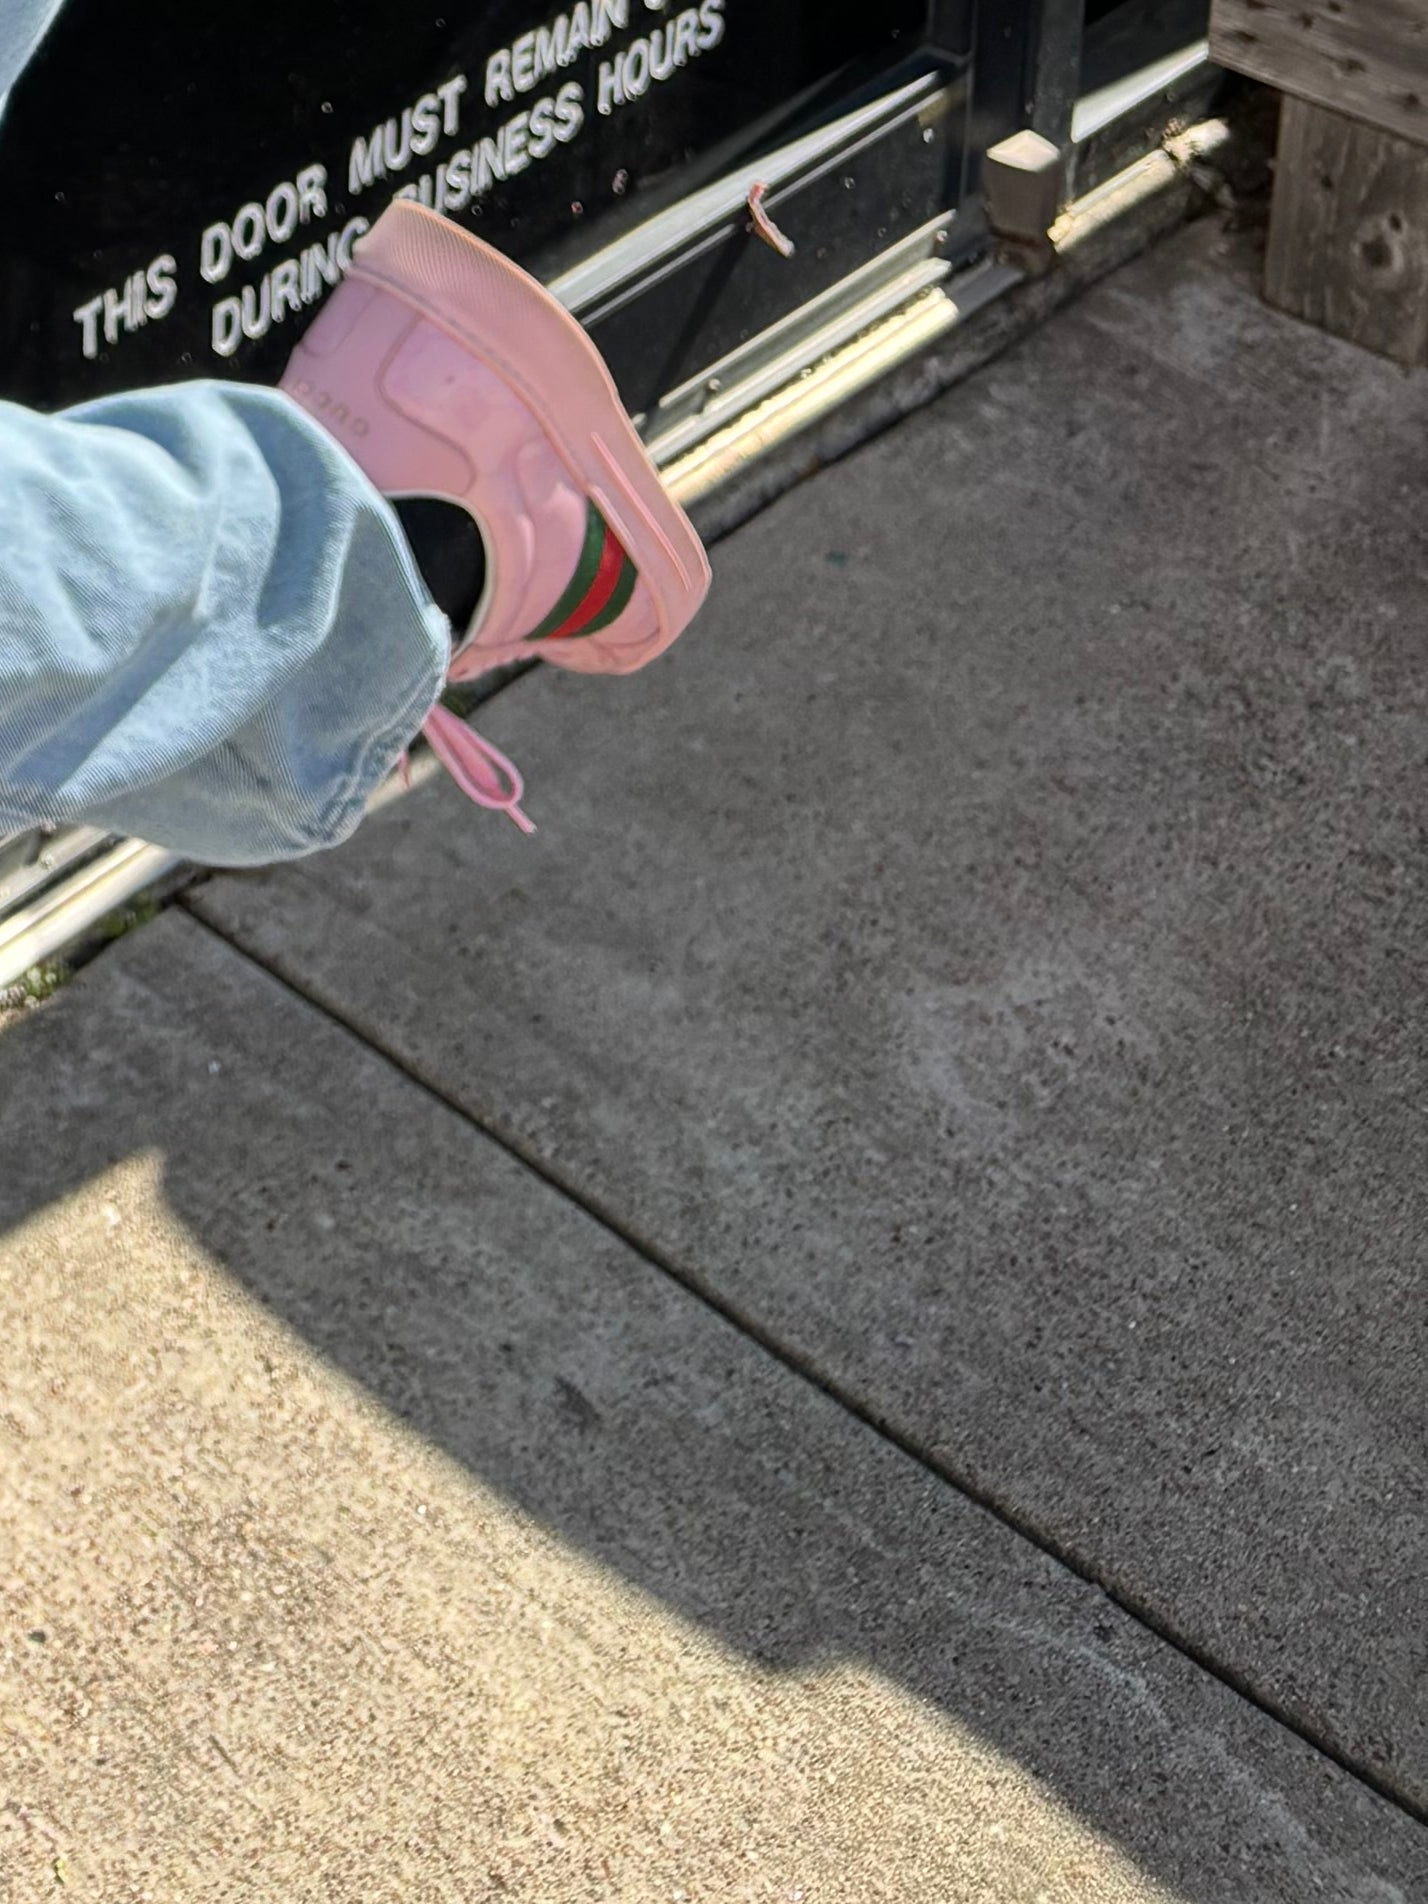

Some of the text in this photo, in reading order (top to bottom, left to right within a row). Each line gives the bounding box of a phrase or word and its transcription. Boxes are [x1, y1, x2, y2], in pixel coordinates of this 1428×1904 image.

[73, 253, 178, 360] THIS
[199, 162, 329, 285] DOOR
[347, 76, 467, 195] MUST
